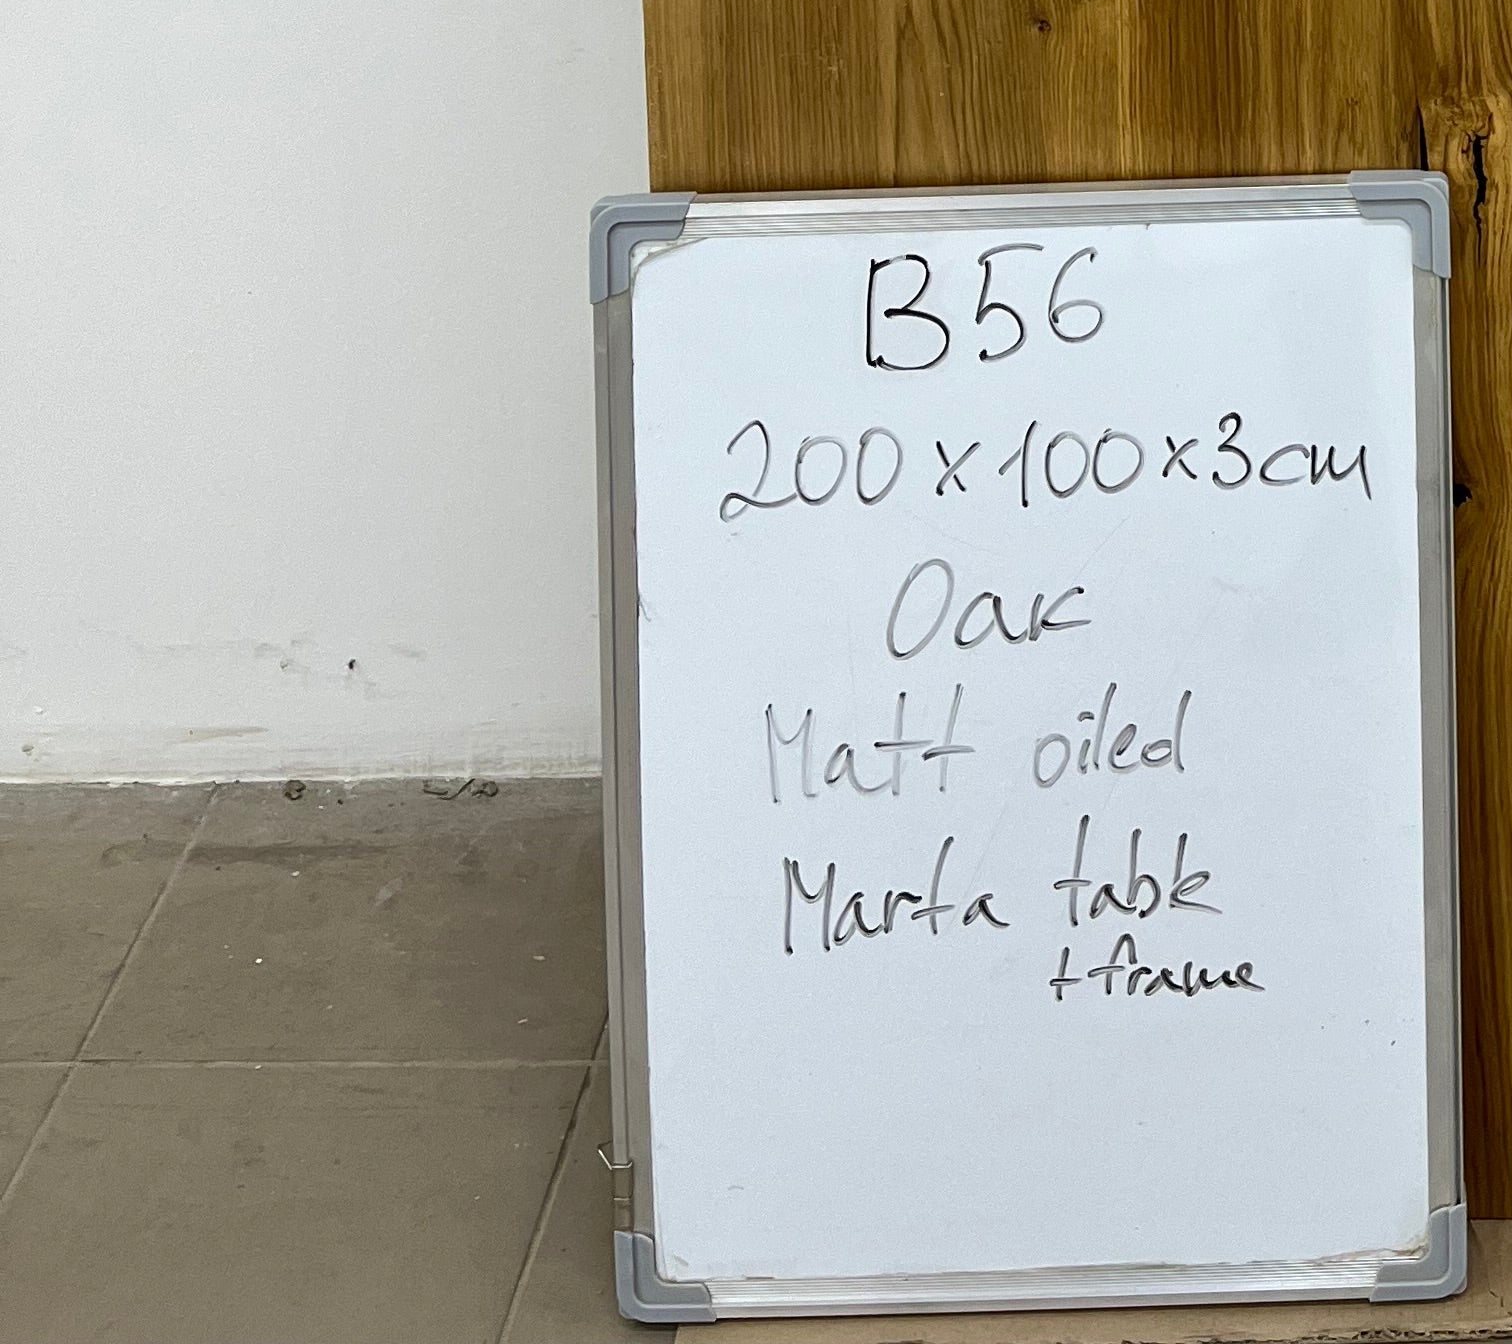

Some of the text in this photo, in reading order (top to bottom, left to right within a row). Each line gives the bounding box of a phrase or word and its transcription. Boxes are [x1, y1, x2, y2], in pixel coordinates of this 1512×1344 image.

[865, 242, 1106, 372] B56
[884, 557, 1093, 661] Oak
[764, 681, 1193, 805] Matt oiled
[782, 835, 1012, 957] Marta
